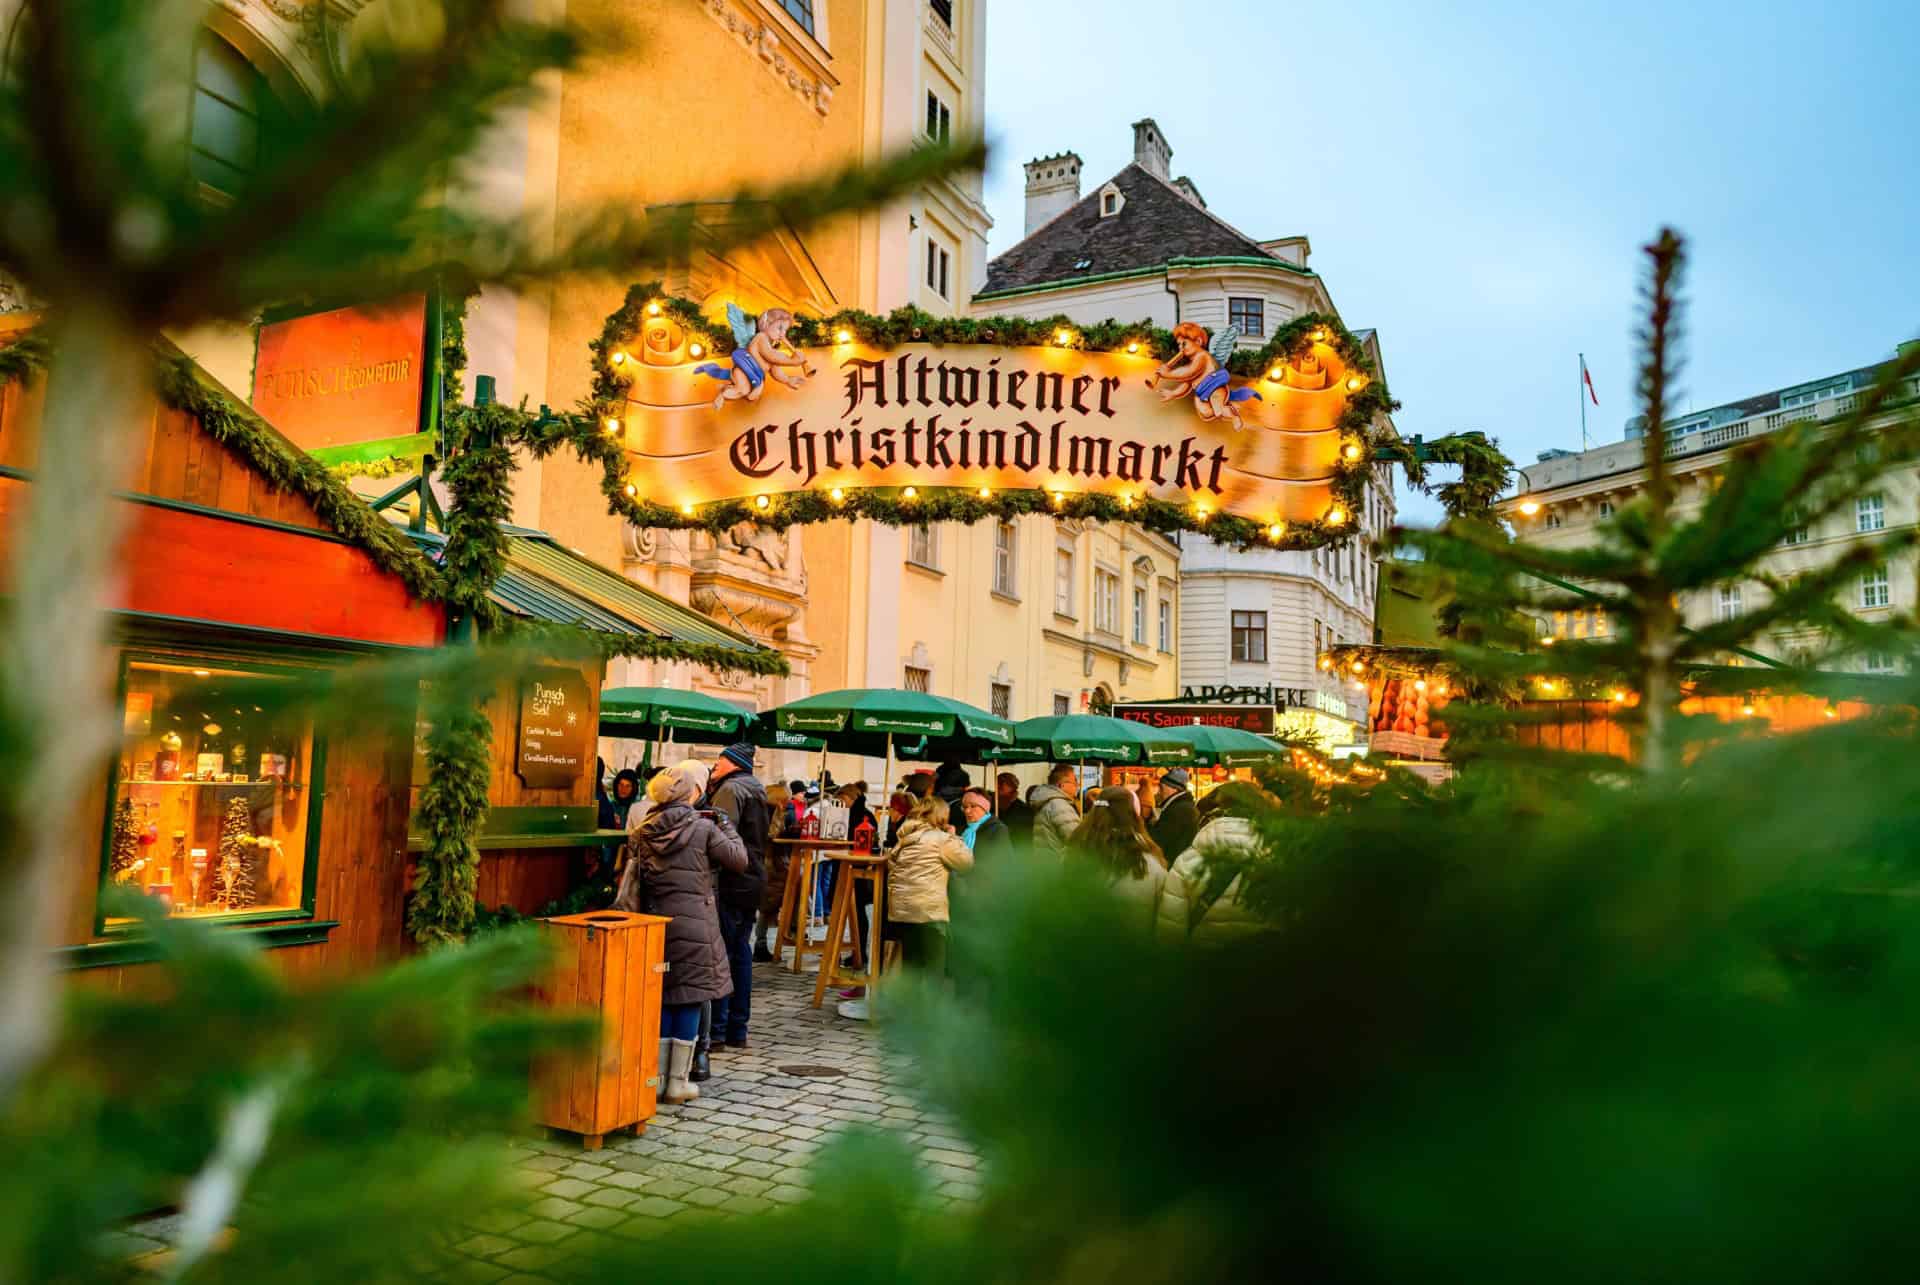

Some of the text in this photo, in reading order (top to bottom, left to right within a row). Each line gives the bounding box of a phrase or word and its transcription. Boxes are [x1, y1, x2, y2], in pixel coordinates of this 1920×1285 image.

[841, 354, 1121, 420] Altwiener
[728, 414, 1231, 496] Christkindlmarkt
[534, 682, 565, 706] Punsch
[1183, 685, 1309, 707] APOTHEKE
